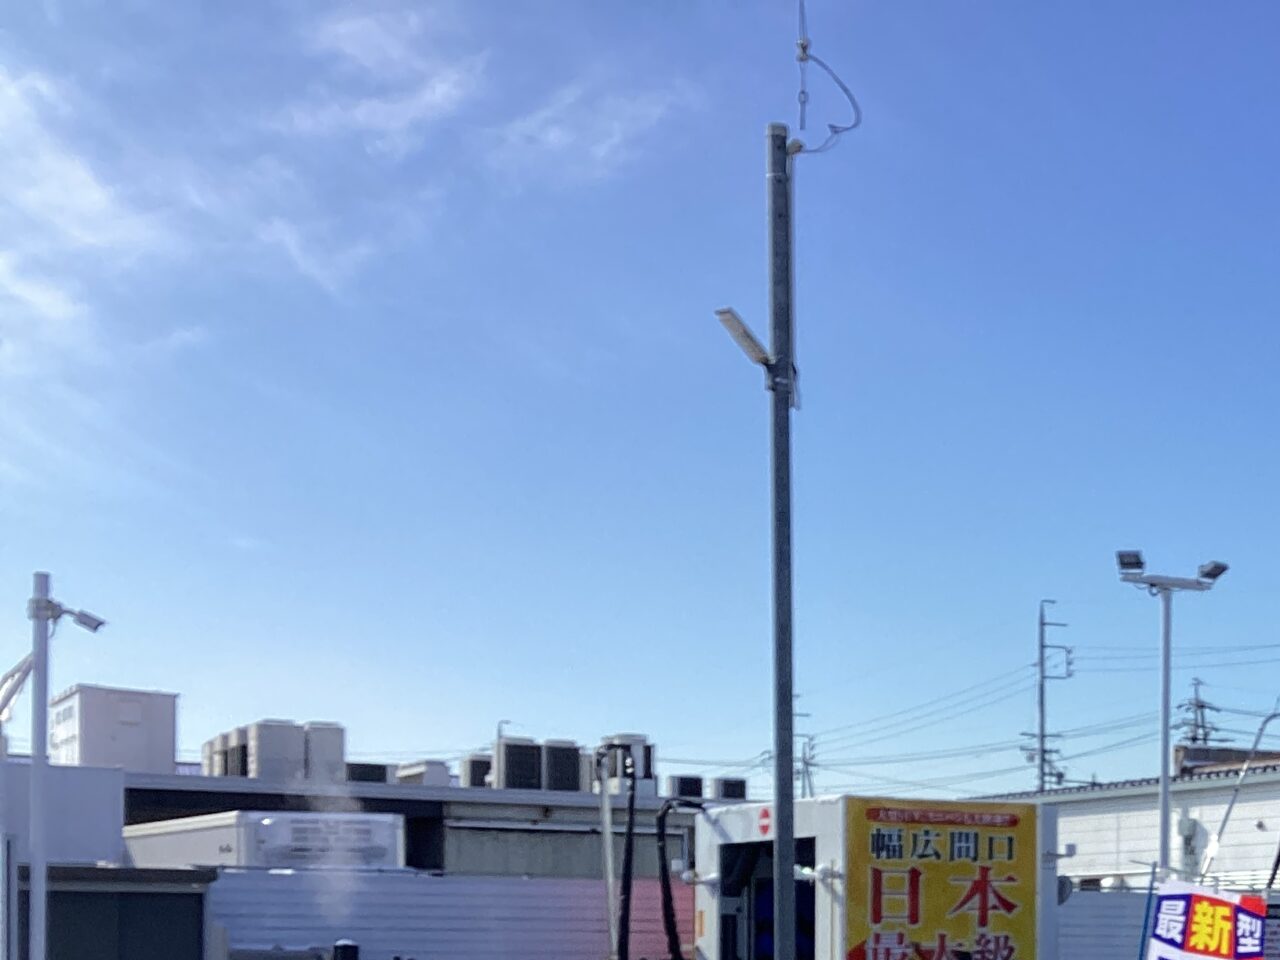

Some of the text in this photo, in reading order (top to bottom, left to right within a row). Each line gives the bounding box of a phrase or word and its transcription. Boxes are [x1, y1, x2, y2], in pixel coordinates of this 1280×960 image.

[871, 829, 1014, 861] 幅広間口
[870, 866, 1018, 927] 日本
[1153, 899, 1263, 955] 最新型
